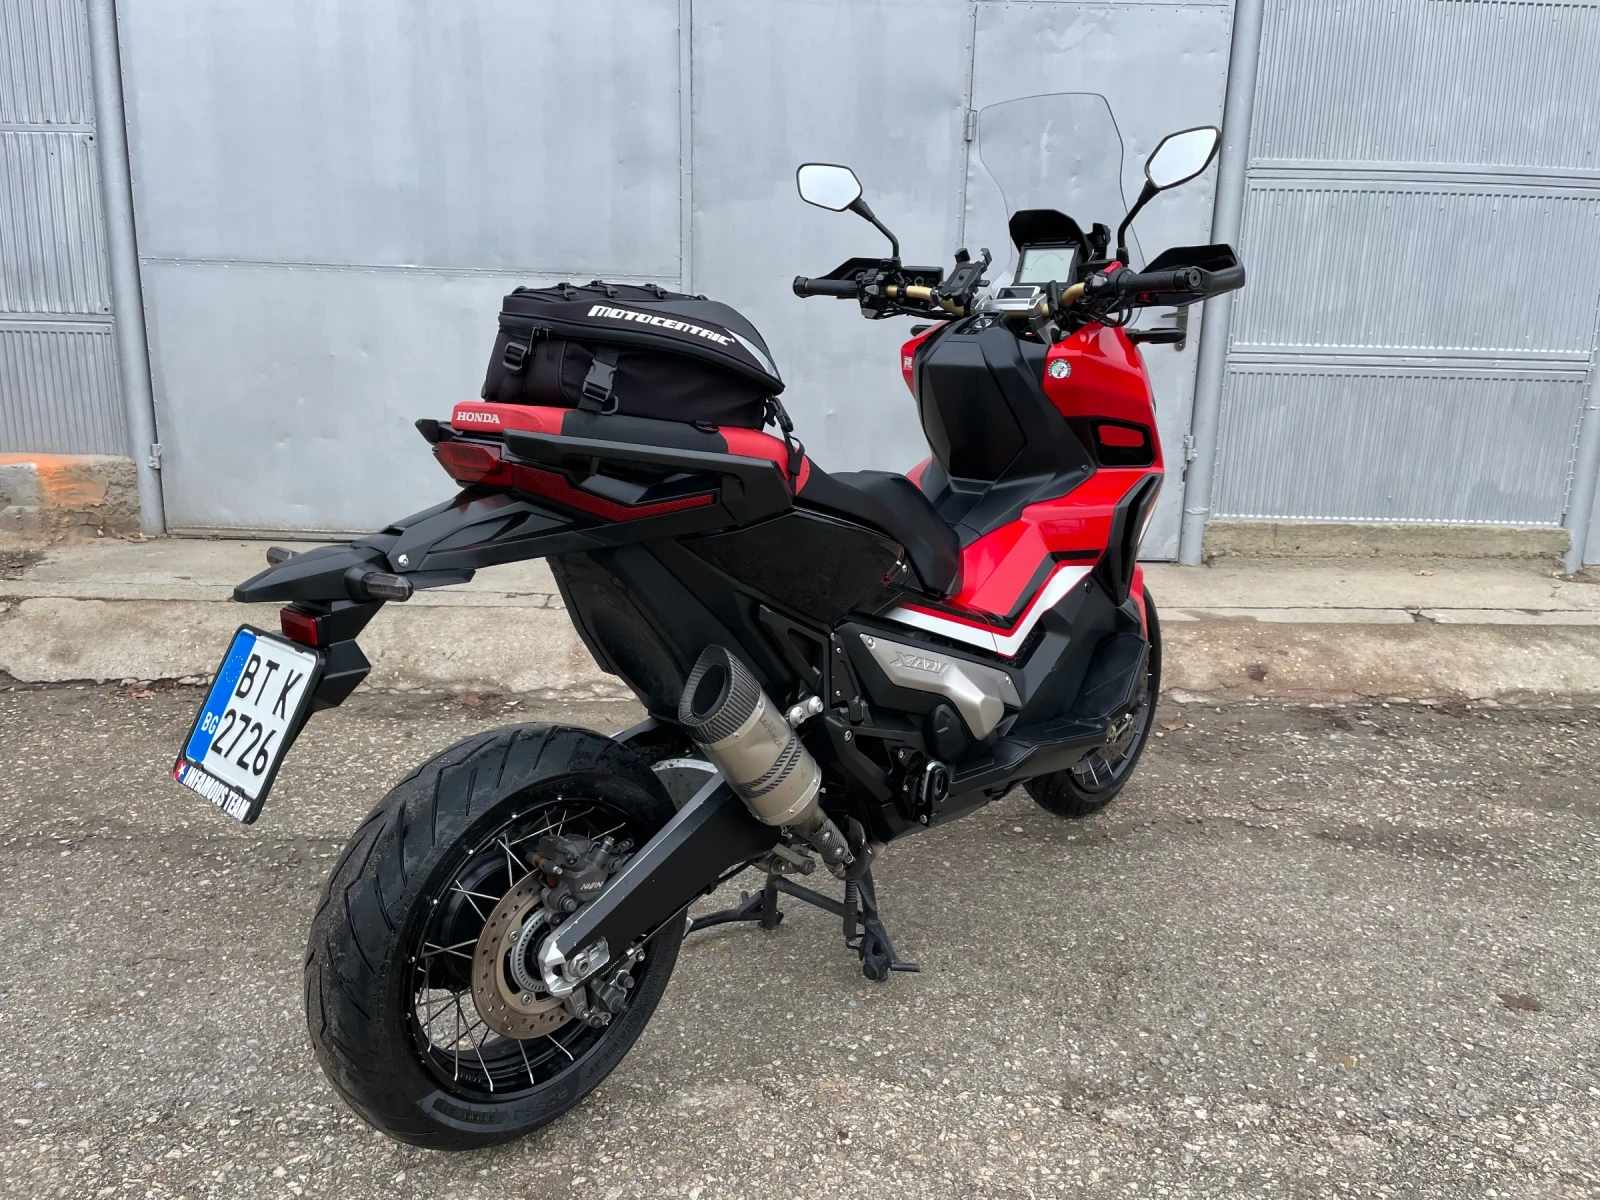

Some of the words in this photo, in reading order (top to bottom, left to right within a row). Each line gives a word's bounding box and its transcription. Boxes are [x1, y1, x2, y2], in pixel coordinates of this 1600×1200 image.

[587, 304, 732, 346] MOTOCENTRIC
[456, 410, 500, 425] HONDA
[201, 711, 219, 734] BG
[210, 708, 278, 776] 2726
[182, 765, 229, 807] INFAMOUS
[223, 790, 251, 821] TEAM
